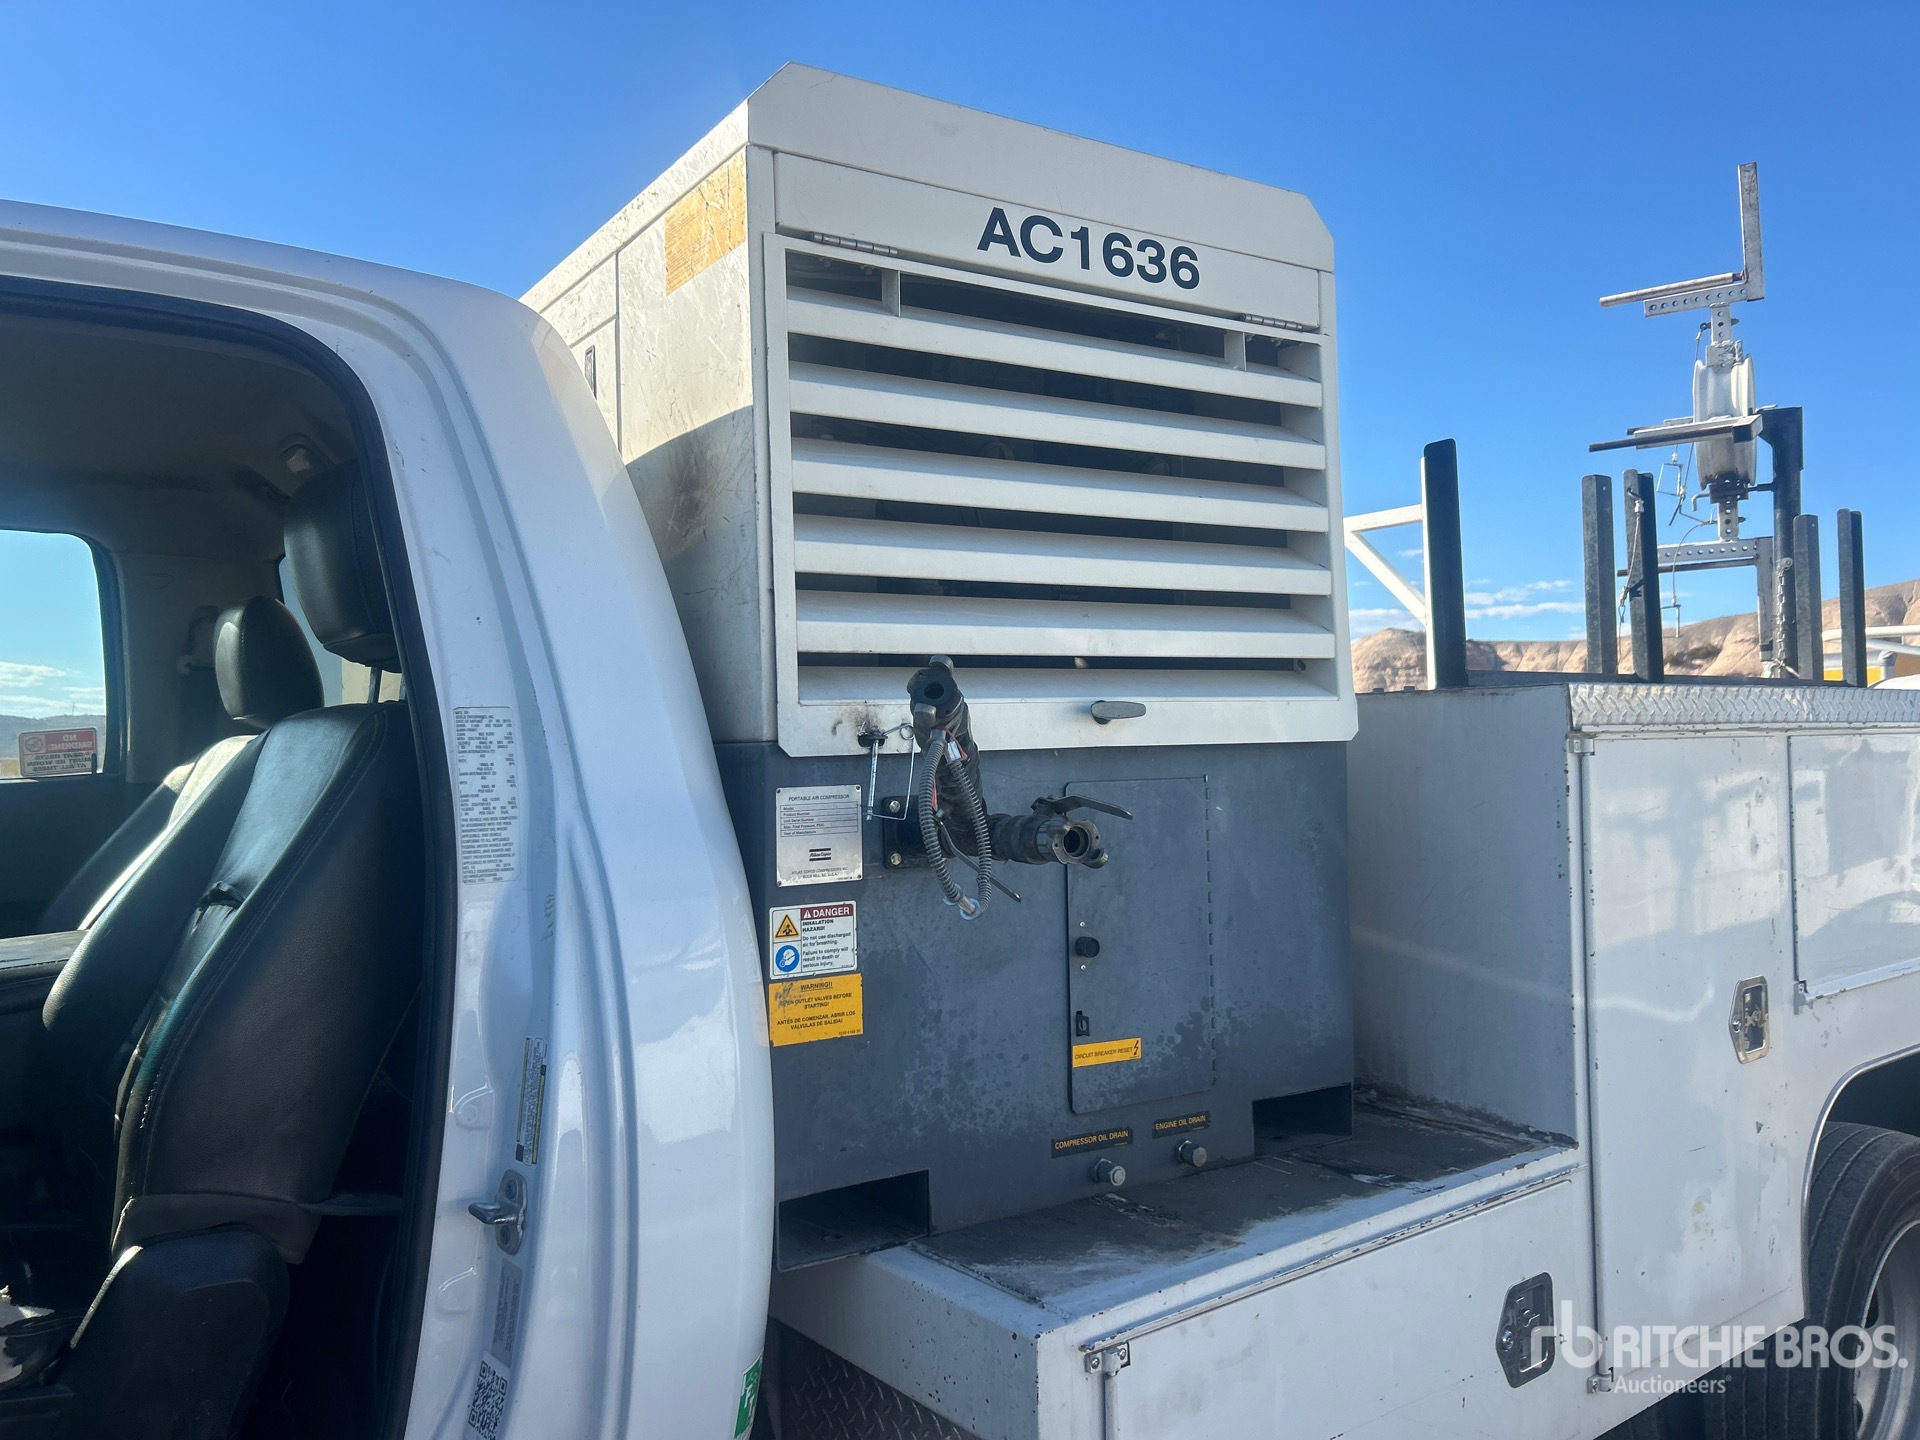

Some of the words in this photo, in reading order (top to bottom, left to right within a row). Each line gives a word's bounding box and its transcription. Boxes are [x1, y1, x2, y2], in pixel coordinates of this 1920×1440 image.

[977, 207, 1199, 289] AC1636
[813, 907, 850, 918] DANGER
[801, 982, 832, 990] WARNING!!
[1075, 1052, 1094, 1060] CIRCUIT
[1095, 1049, 1117, 1057] BREAKER
[1155, 1120, 1178, 1130] ENGINE
[1178, 1119, 1187, 1127] OIL
[1188, 1115, 1206, 1124] DRAIN
[1055, 1135, 1097, 1149] COMPRESSOR
[1099, 1134, 1108, 1142] OIL
[1109, 1130, 1128, 1139] DRAIN
